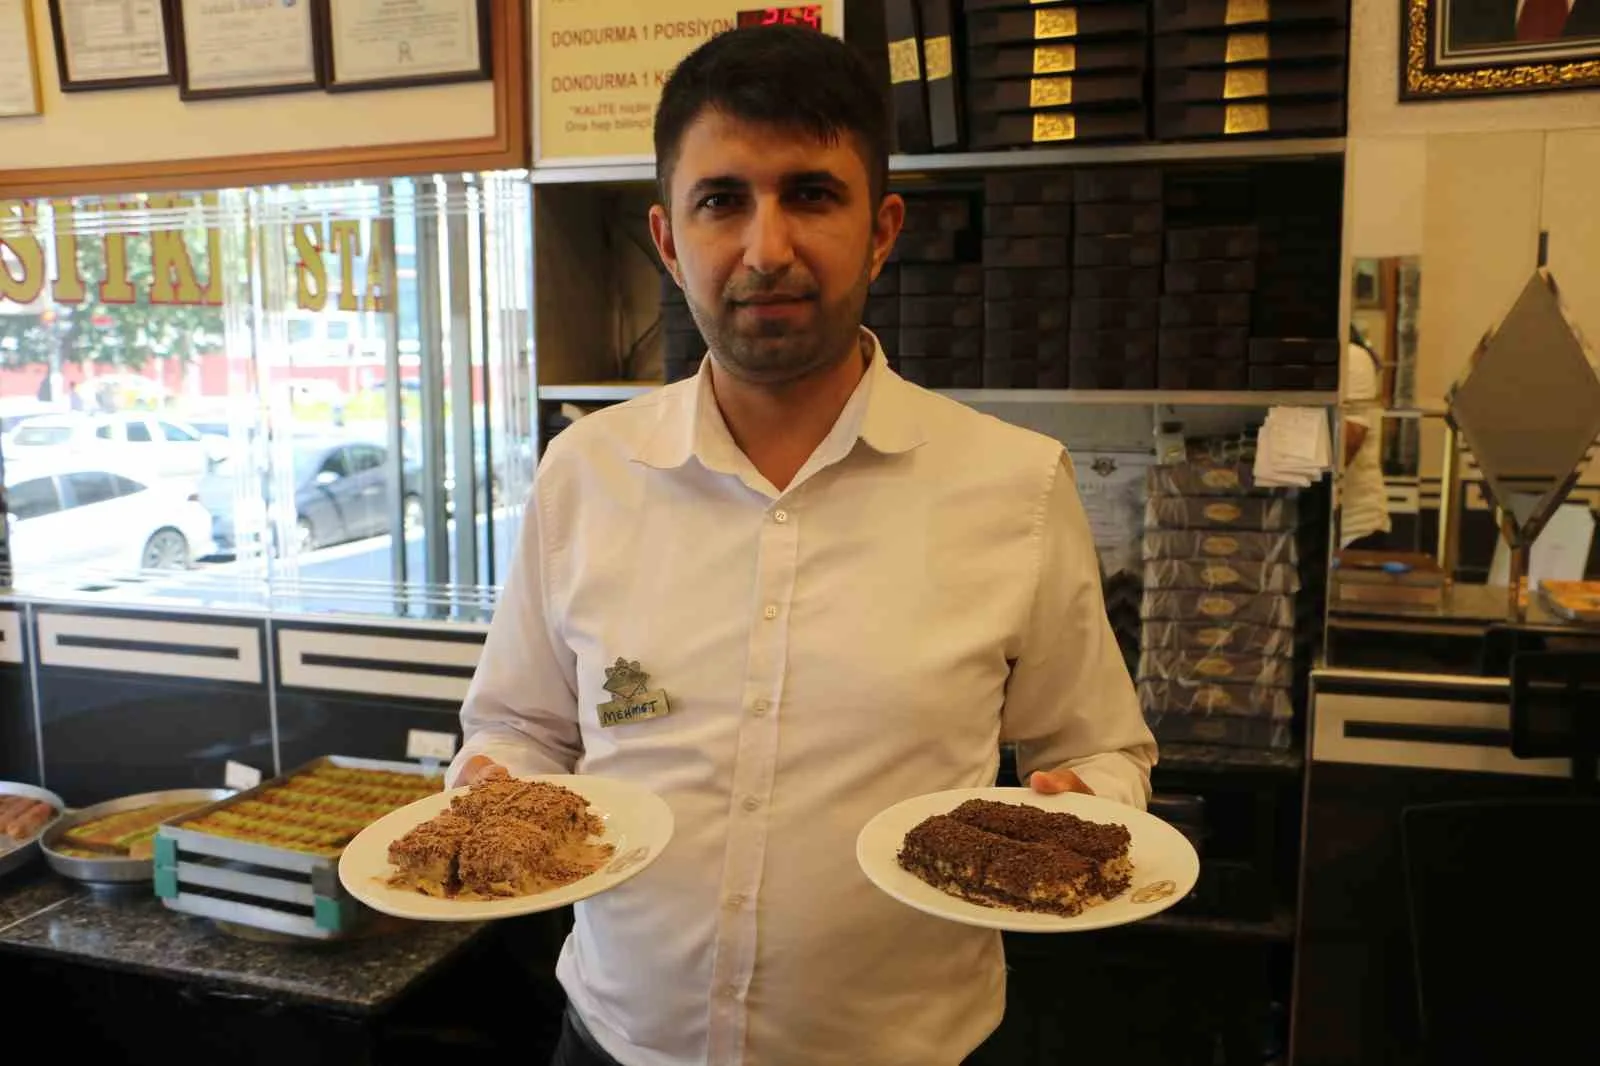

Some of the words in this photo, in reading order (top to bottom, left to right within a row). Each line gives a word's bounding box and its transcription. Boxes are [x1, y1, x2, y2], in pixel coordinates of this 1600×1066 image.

[551, 25, 638, 48] DONDURMA
[642, 24, 648, 40] 1
[551, 71, 638, 93] DONDURMA
[642, 71, 648, 88] 1
[602, 700, 659, 724] MEHMET
